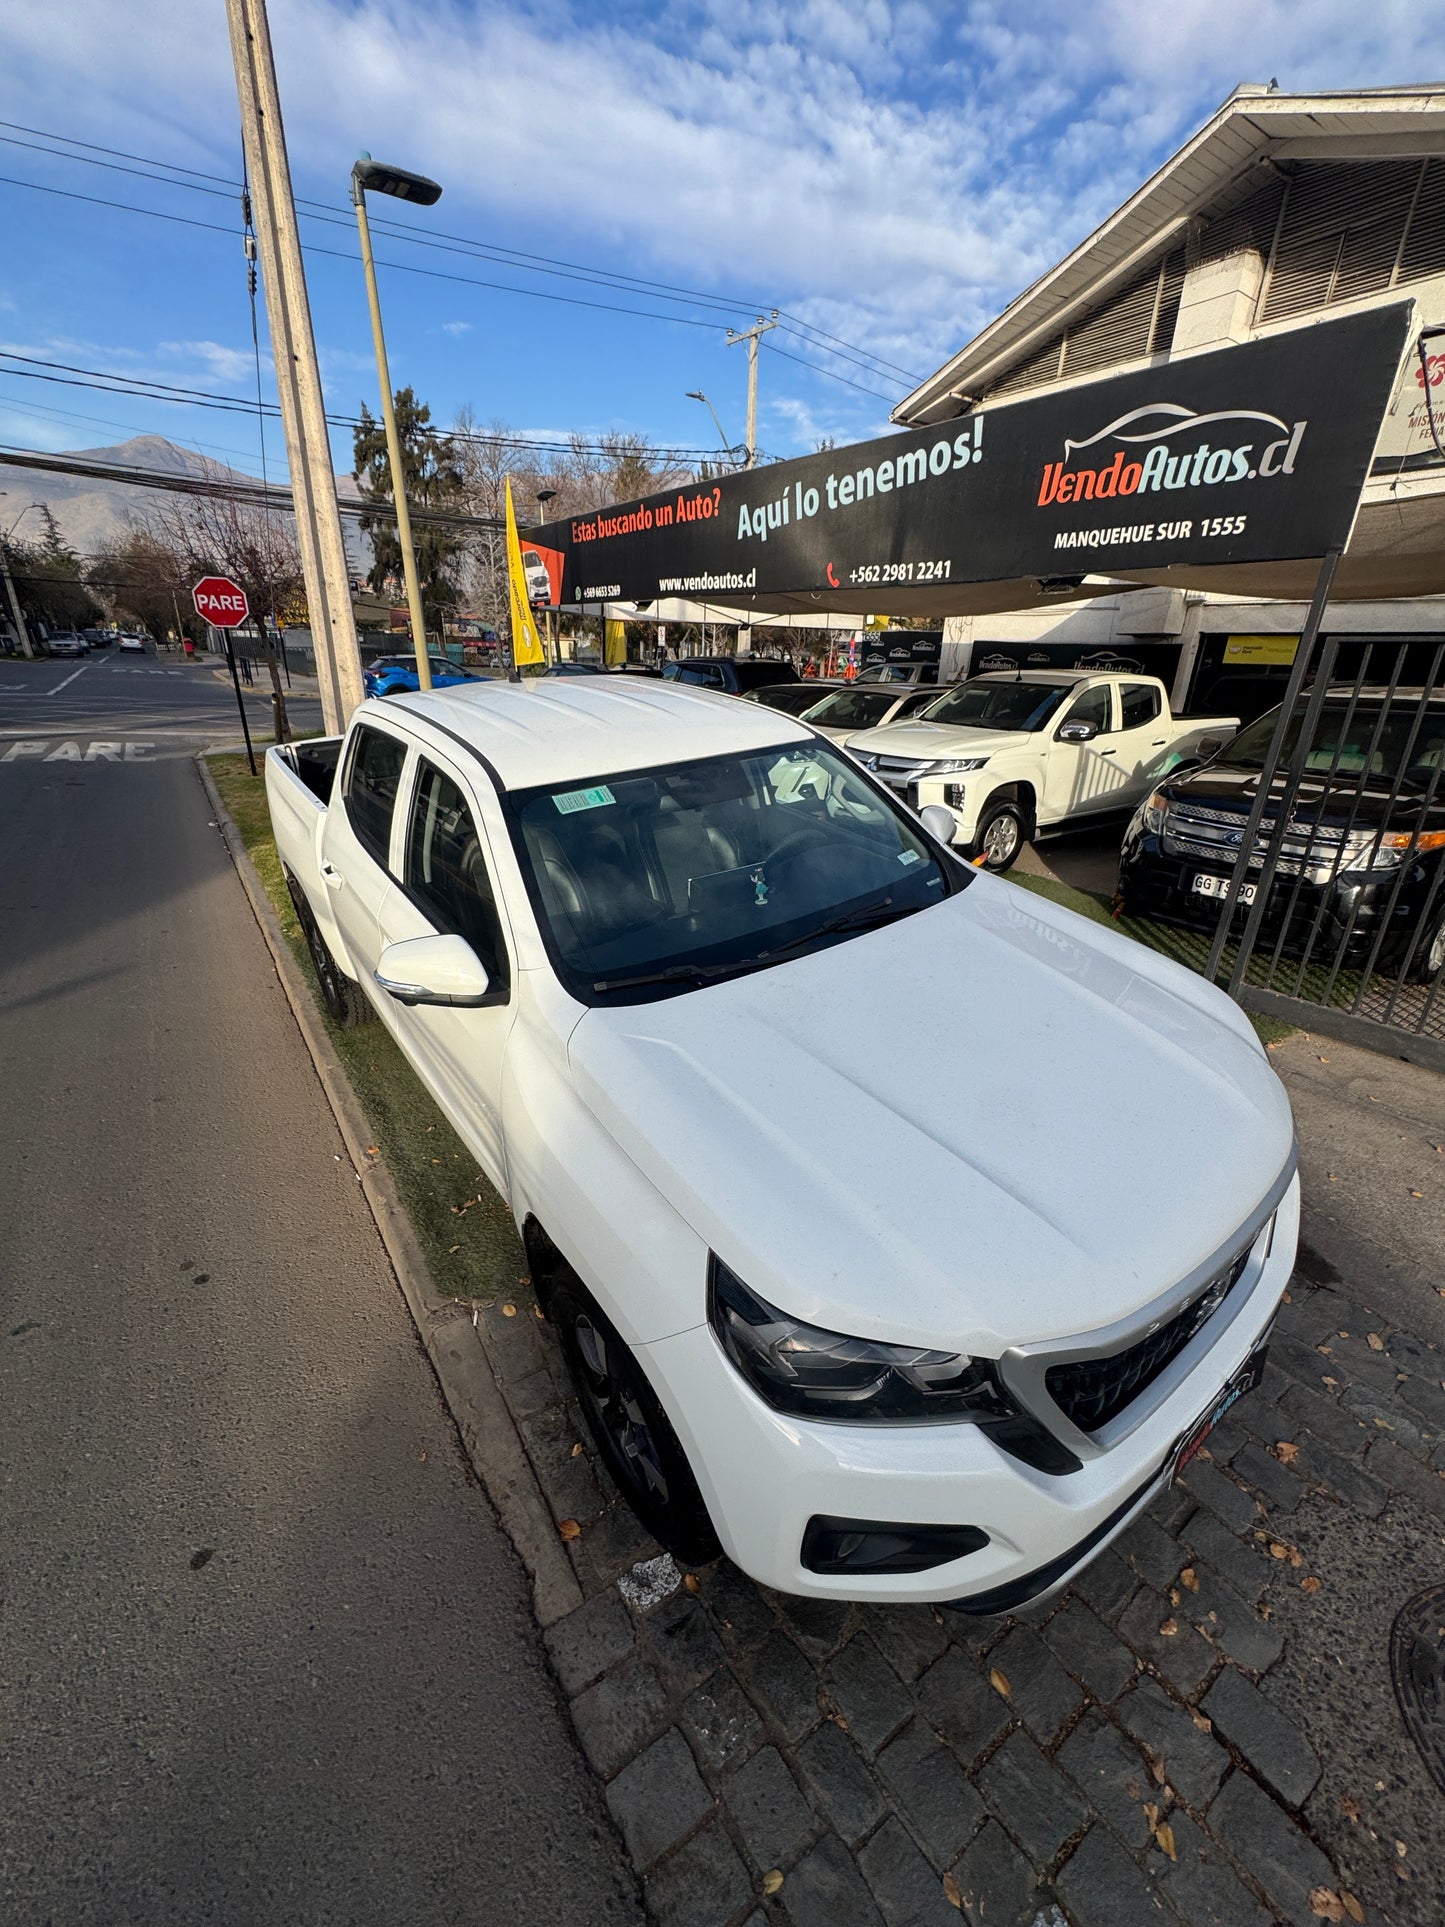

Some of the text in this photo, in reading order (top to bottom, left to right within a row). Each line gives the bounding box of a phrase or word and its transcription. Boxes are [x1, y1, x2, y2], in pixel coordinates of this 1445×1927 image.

[1419, 425, 1445, 439] FEIA
[1037, 421, 1307, 506] VendoAutos.cl
[737, 415, 984, 542] Aquí lo tenemos!
[571, 487, 721, 544] Estas buscando un Auto?
[1054, 515, 1247, 549] MANQUEHUE SUR 1555
[659, 567, 756, 591] www.vendoautos.cl
[849, 560, 952, 583] +562 2981 2241
[196, 594, 245, 611] PARE
[0, 741, 156, 762] PARE
[1195, 876, 1212, 890] GG
